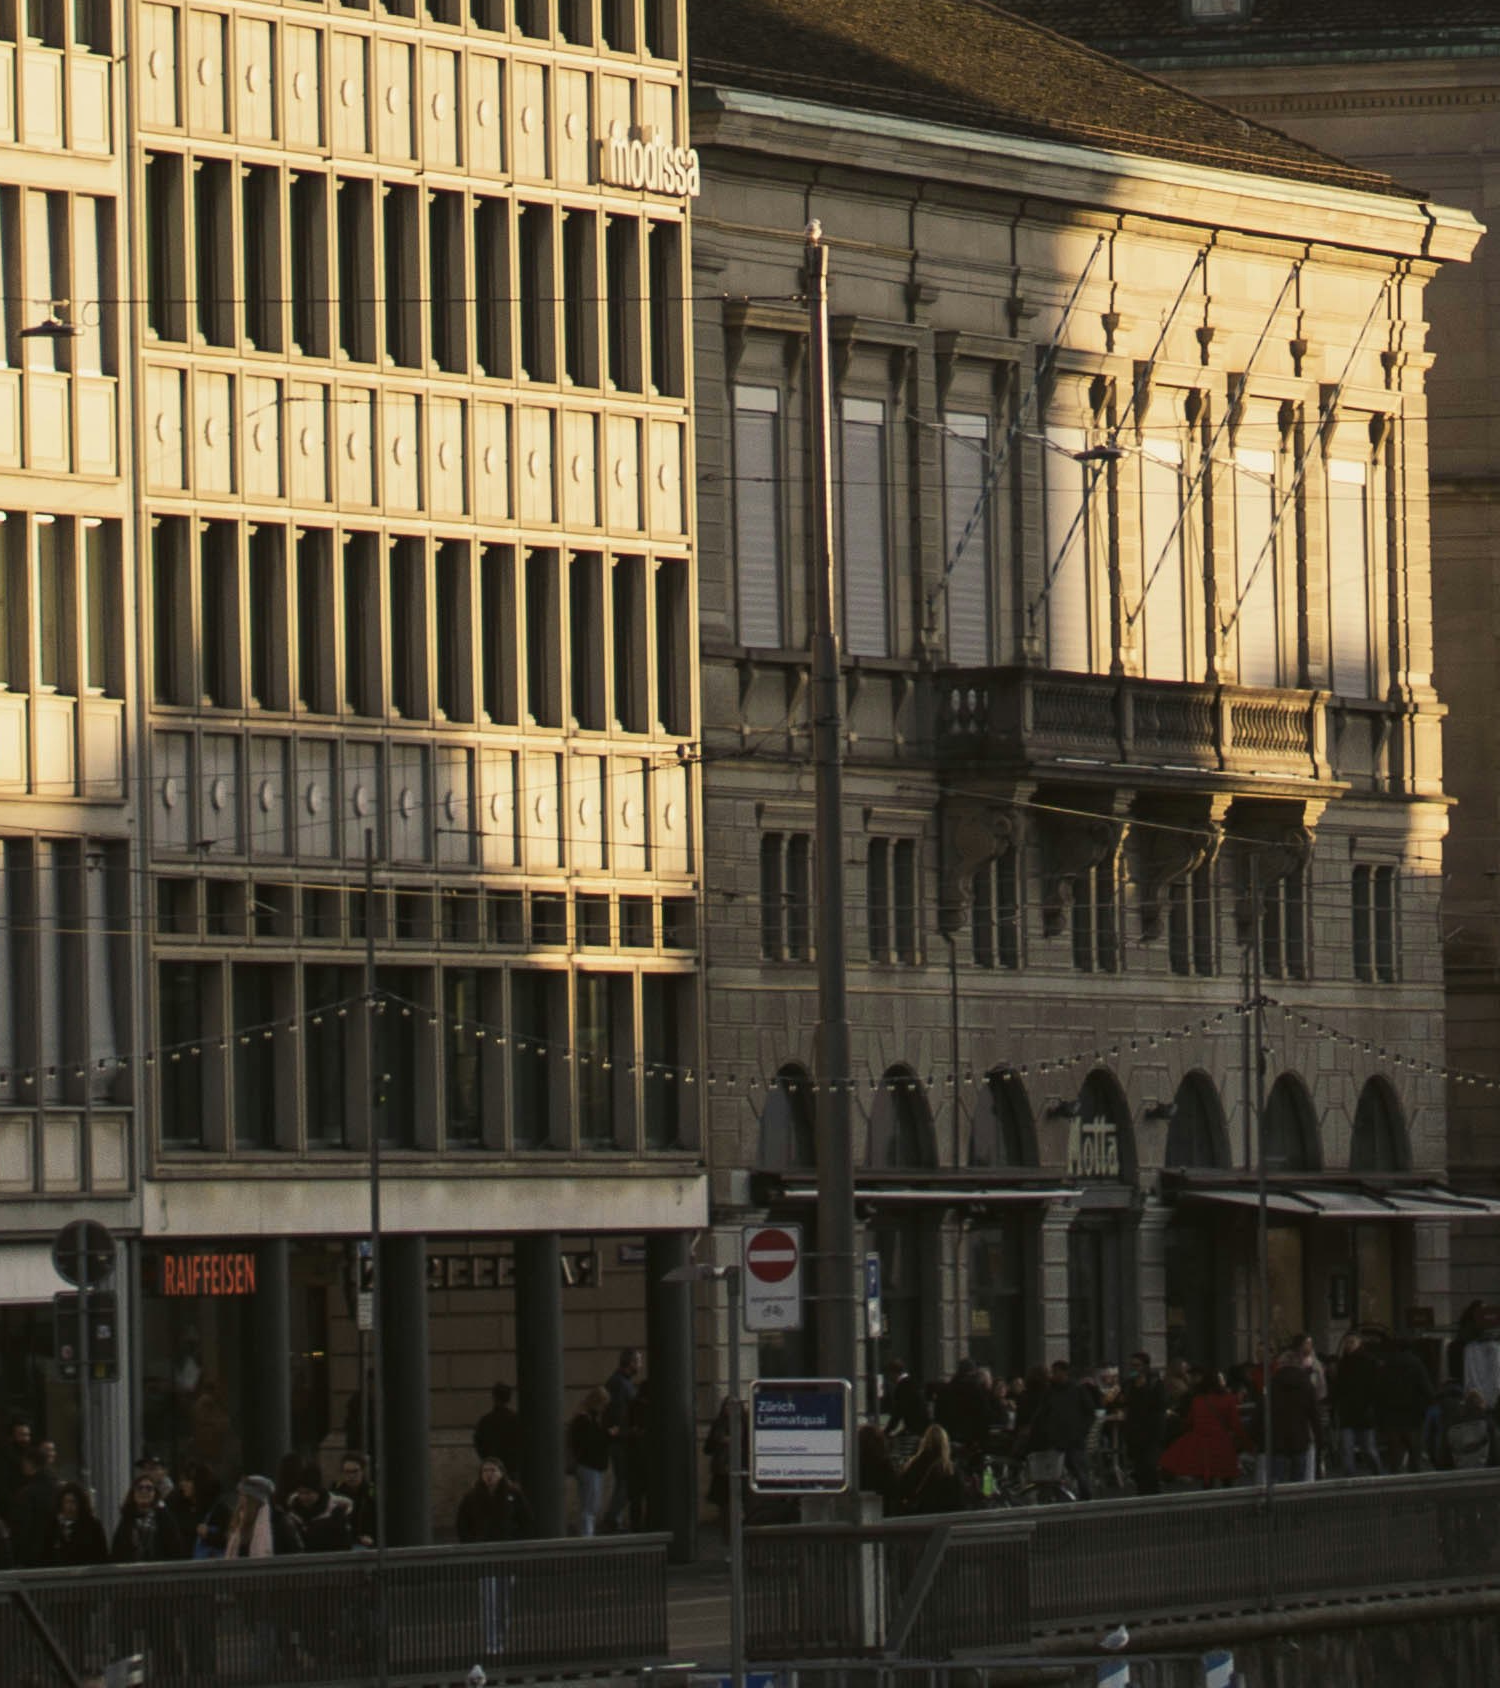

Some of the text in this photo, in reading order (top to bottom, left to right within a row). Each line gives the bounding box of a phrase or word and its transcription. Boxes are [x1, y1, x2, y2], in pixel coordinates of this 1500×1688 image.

[610, 125, 701, 197] modissa
[1067, 1115, 1120, 1177] Motta
[163, 1254, 257, 1297] RAIFFEISEN
[757, 1400, 796, 1413] Zürich
[757, 1413, 828, 1428] Limmatquai
